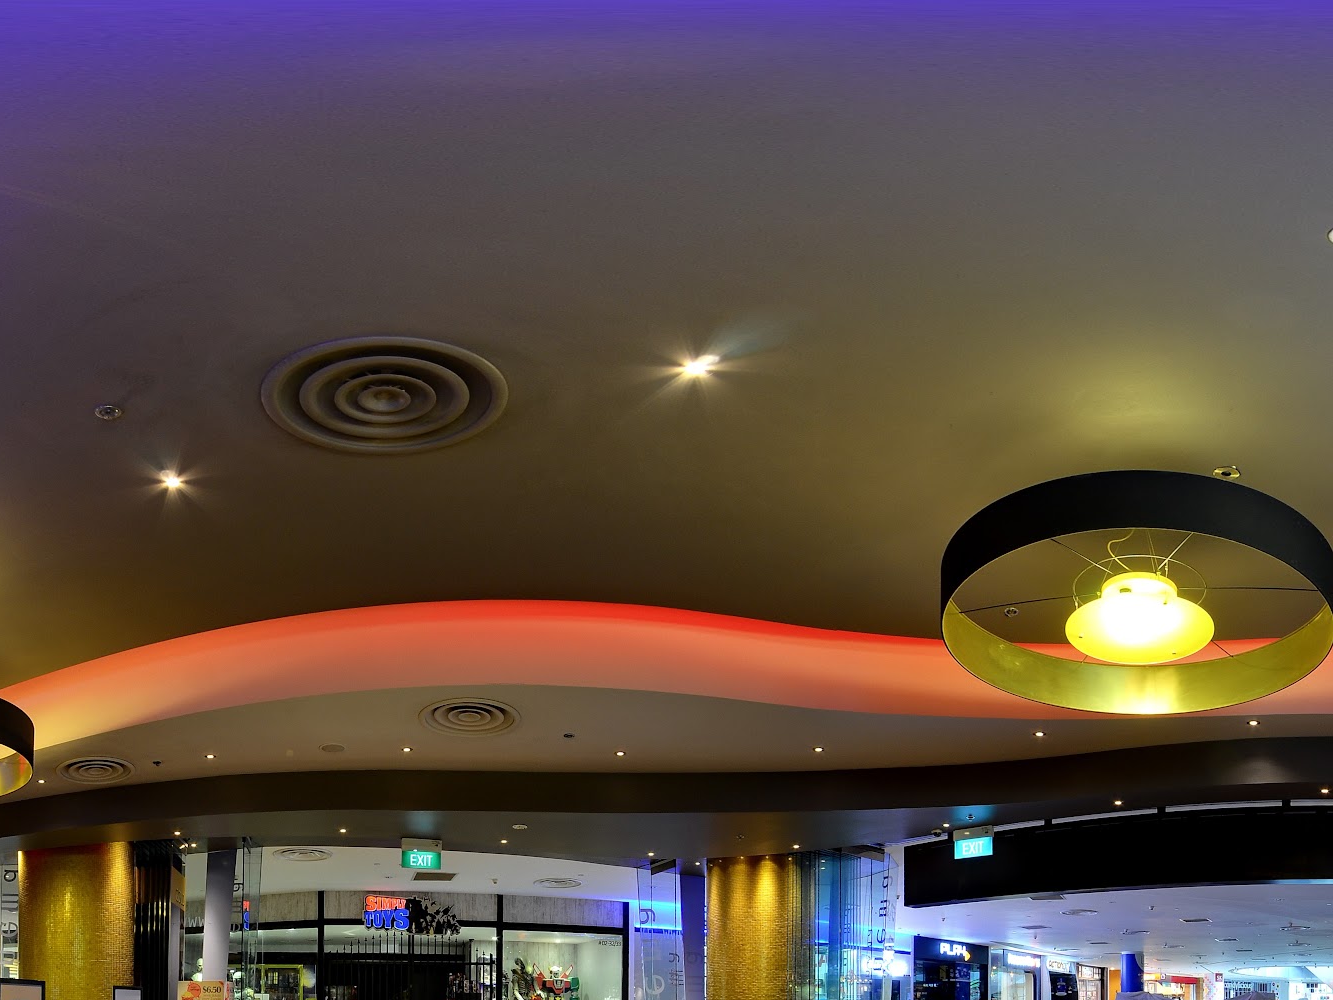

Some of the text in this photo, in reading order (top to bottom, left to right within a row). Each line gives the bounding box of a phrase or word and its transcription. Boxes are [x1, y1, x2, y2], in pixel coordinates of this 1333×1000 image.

[963, 841, 983, 855] EXIT
[410, 853, 433, 866] EXIT
[366, 895, 406, 911] SIMPLY
[364, 909, 409, 930] TOYS
